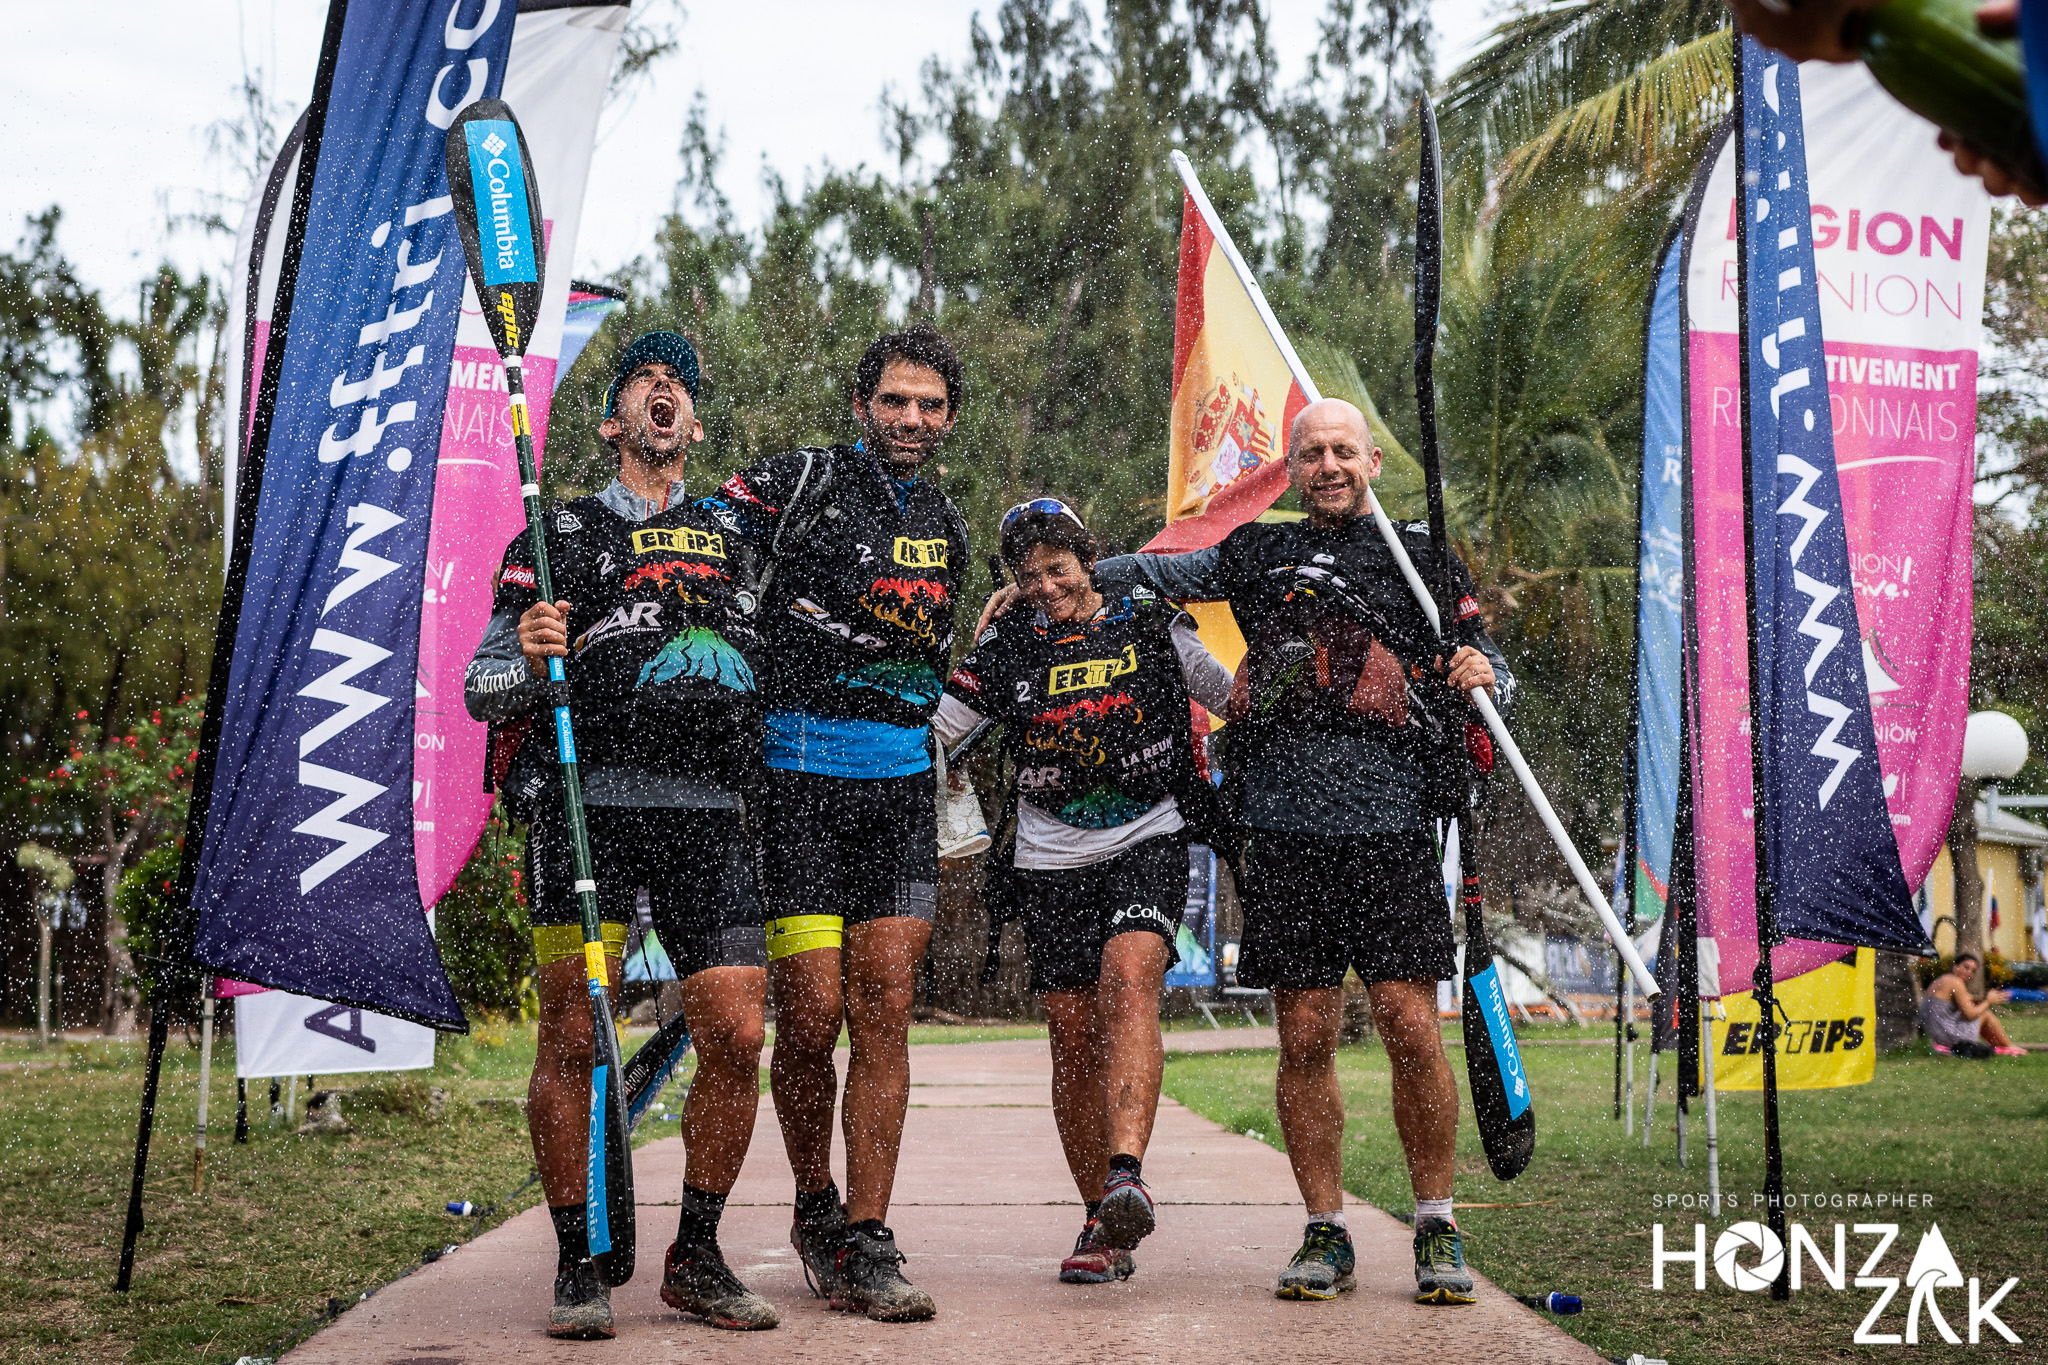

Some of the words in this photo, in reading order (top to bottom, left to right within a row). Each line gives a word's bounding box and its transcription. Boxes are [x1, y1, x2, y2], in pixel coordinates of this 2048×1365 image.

[487, 158, 520, 270] Columbia
[496, 291, 519, 349] epic
[1826, 354, 1961, 391] TIVEMENT
[595, 551, 617, 576] 2
[855, 543, 875, 563] 2
[600, 601, 664, 633] AR
[1016, 680, 1032, 703] 2
[561, 720, 573, 758] Columbia
[531, 820, 546, 909] Columbia
[1489, 977, 1518, 1077] Columbia
[586, 1116, 600, 1240] Columbia
